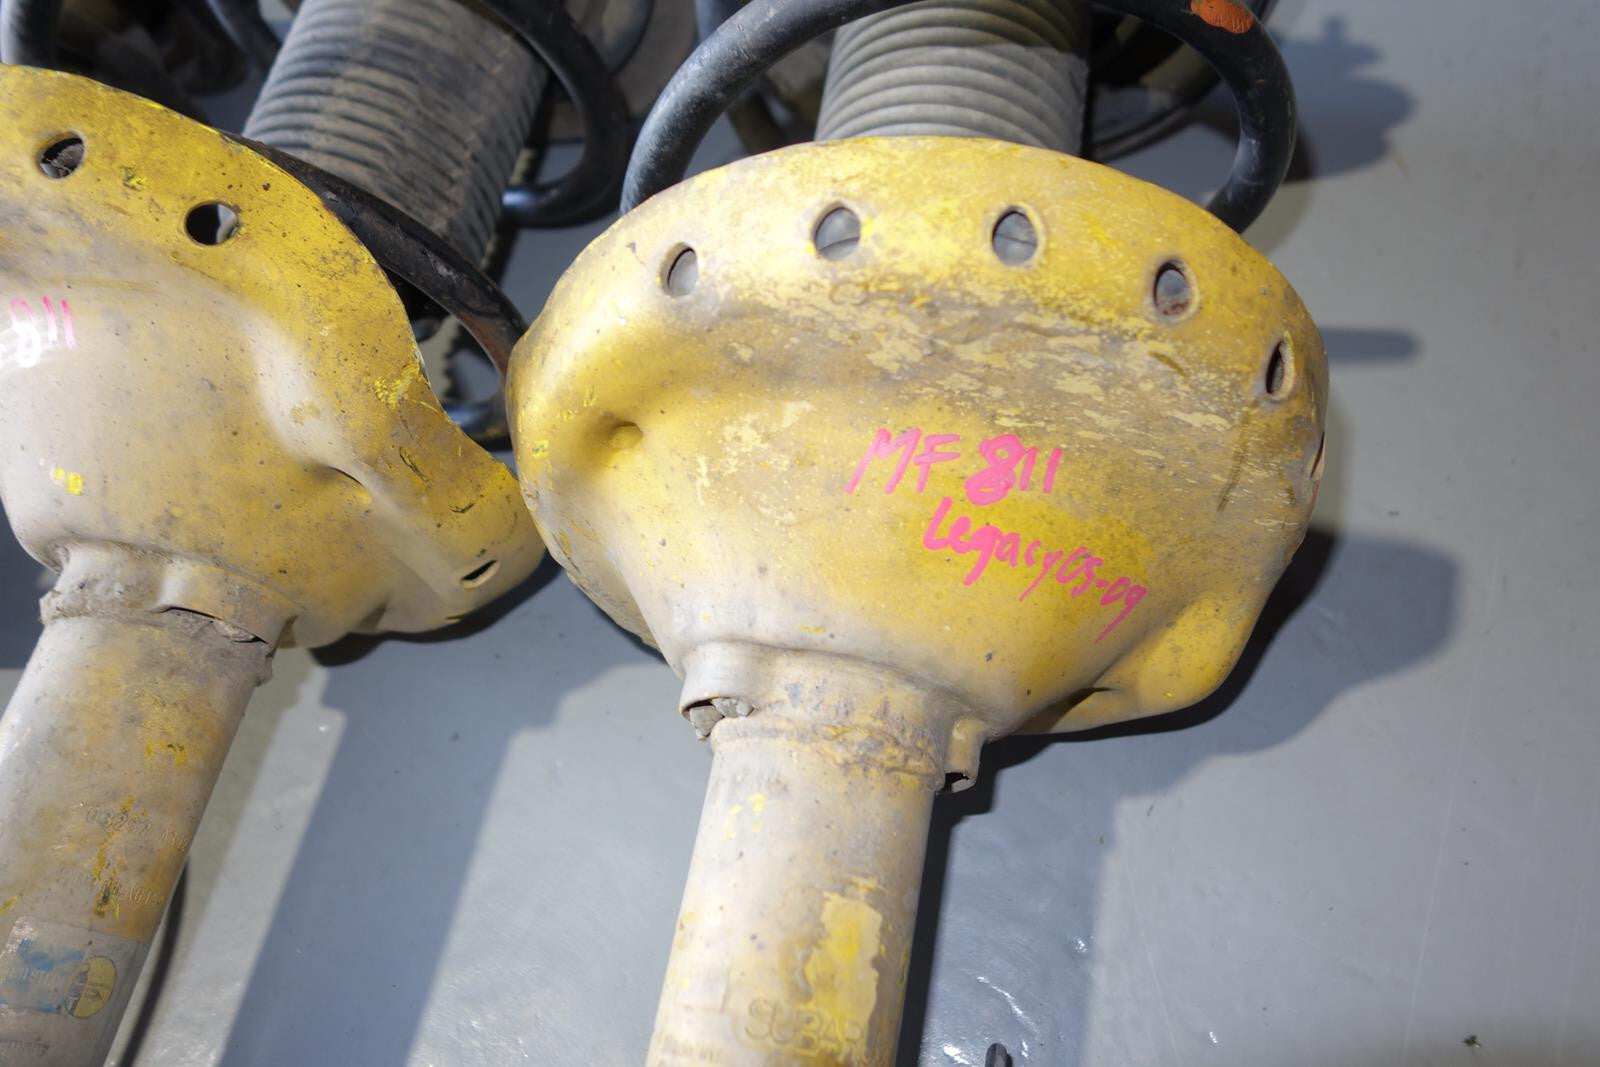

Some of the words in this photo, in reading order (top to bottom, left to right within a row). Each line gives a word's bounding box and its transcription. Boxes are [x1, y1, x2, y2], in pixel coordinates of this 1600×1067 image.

[845, 428, 960, 494] MF
[964, 434, 1063, 506] 811
[923, 497, 1064, 602] Legacy
